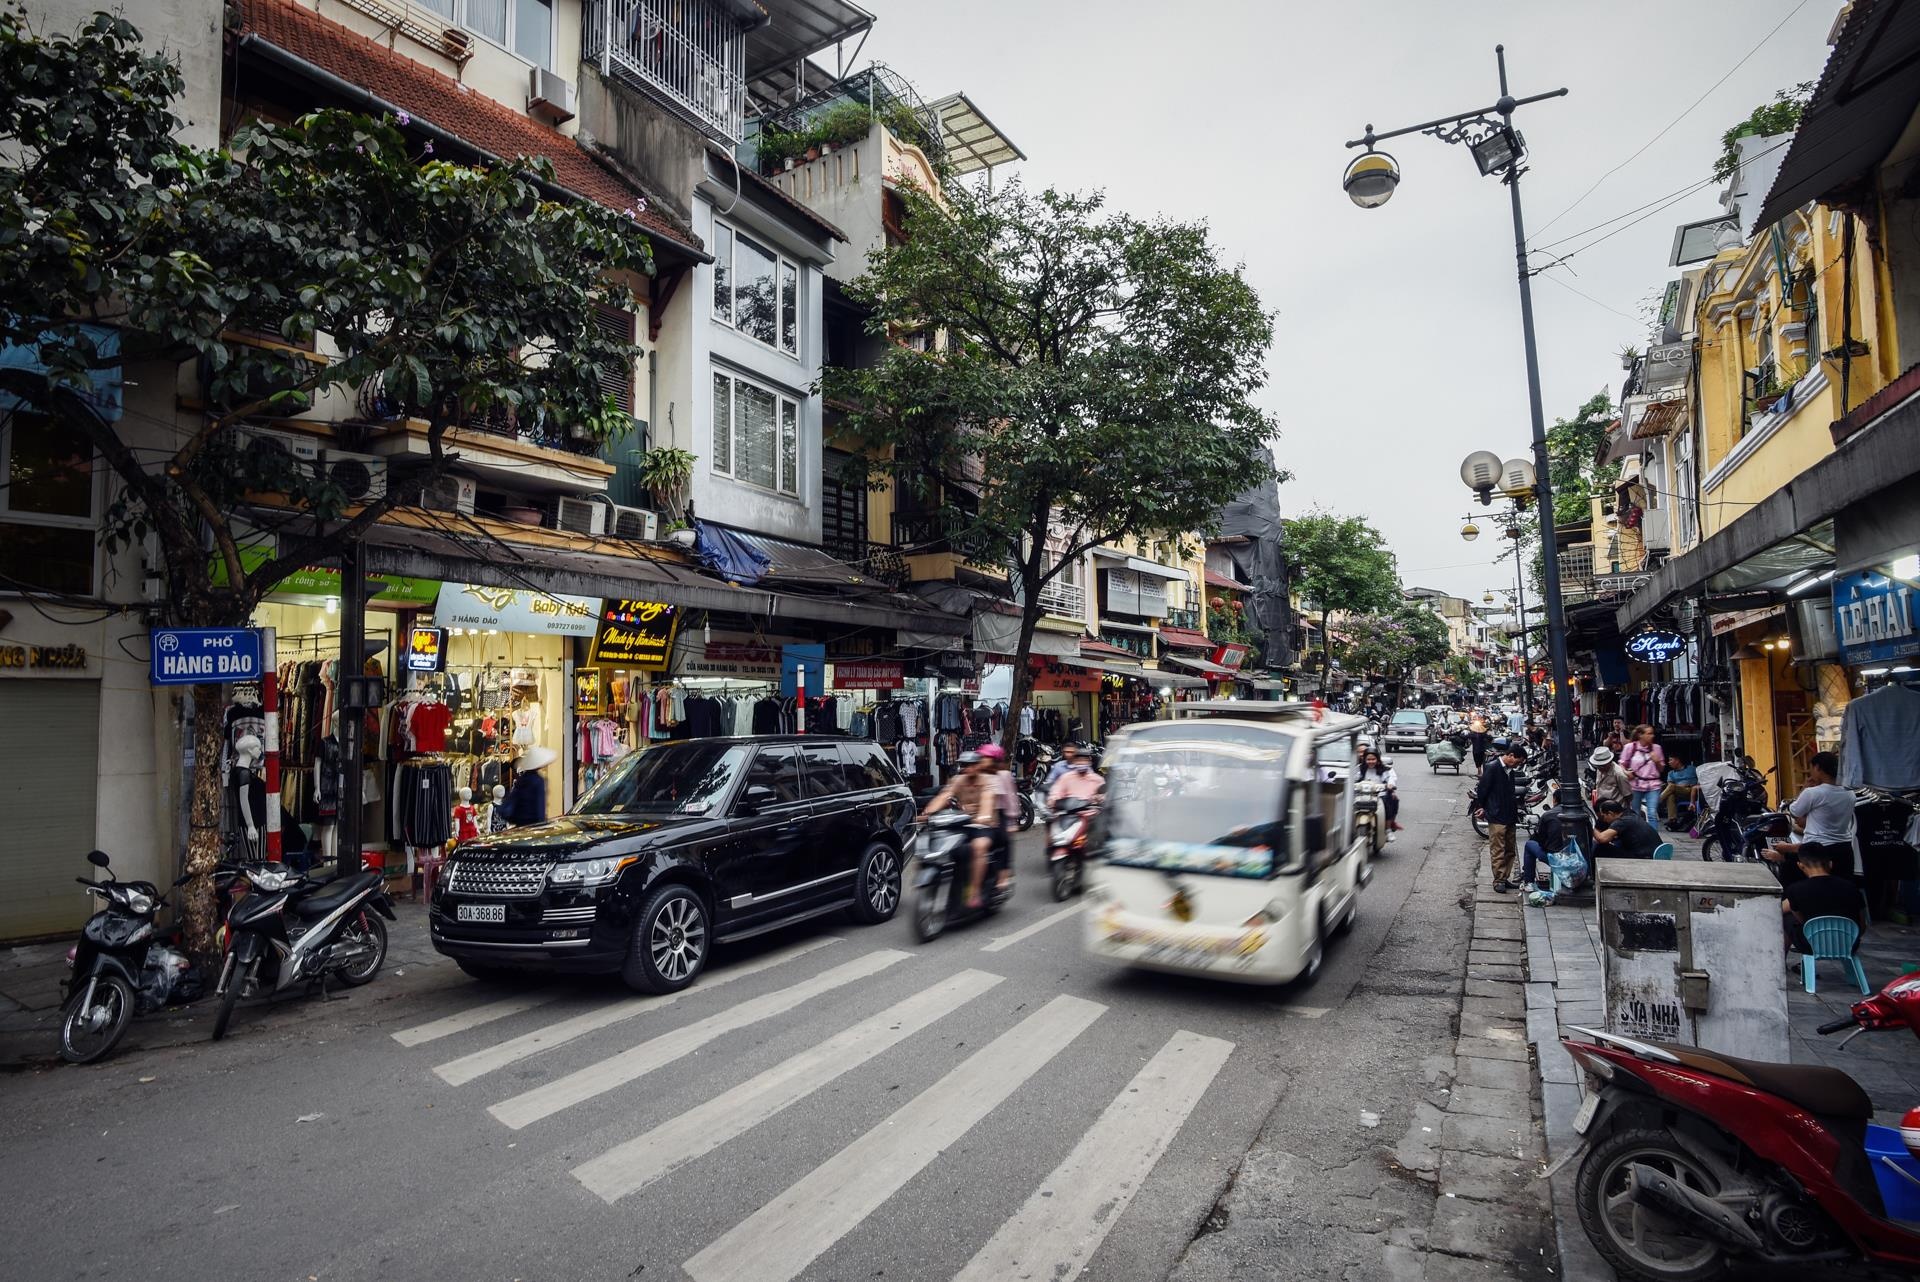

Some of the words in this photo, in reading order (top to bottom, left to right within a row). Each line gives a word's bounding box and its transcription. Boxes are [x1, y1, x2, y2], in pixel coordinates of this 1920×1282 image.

[532, 599, 562, 617] Baby
[564, 602, 591, 617] Kids
[203, 634, 234, 648] PHỐ
[603, 627, 627, 645] Made
[625, 632, 636, 651] by
[163, 651, 213, 675] HÀNG
[218, 650, 252, 673] ĐÀO
[1647, 651, 1666, 660] 12
[457, 905, 504, 922] 30A-368.86
[1651, 1001, 1681, 1027] NHÀ
